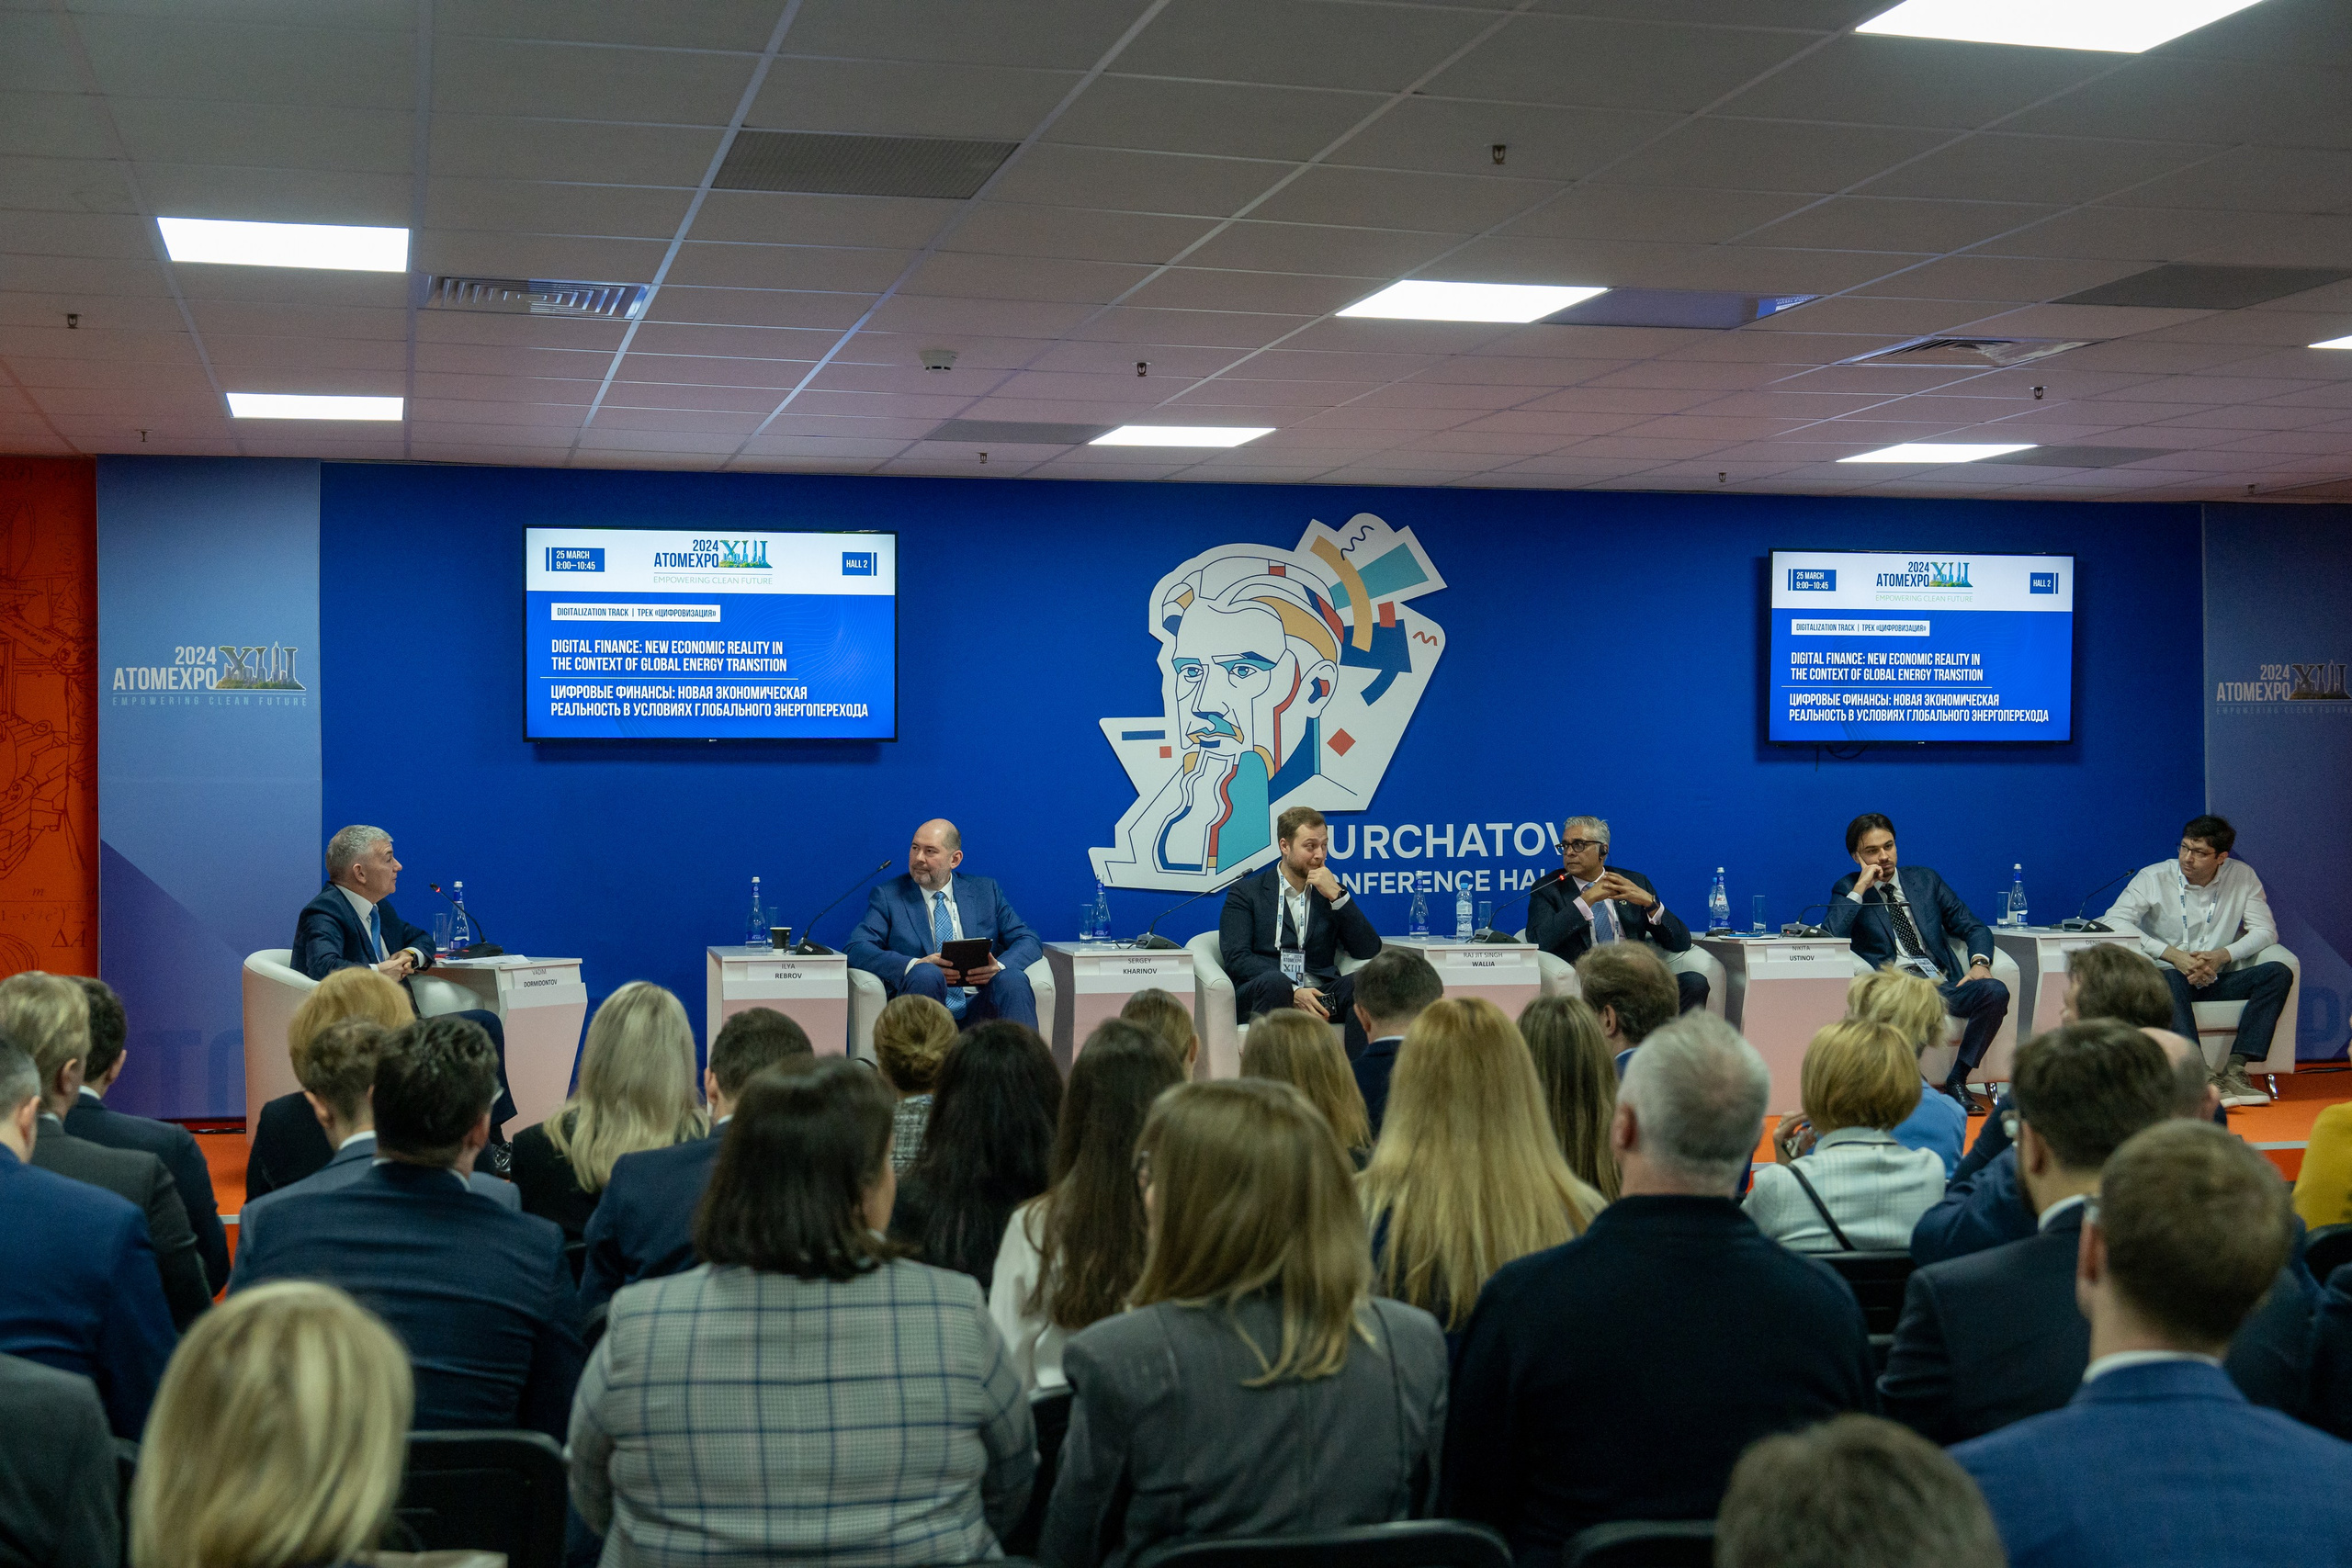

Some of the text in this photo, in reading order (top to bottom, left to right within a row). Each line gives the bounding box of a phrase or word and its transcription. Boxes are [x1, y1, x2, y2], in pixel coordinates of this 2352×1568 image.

[693, 540, 719, 552] 2024
[556, 550, 590, 559] 25 MARCH
[654, 553, 719, 568] ATOMEXPO
[846, 559, 868, 568] HALL 2
[1908, 562, 1930, 573] 2024
[654, 576, 710, 584] EMPOWERING
[712, 576, 739, 584] CLEAN
[1876, 574, 1930, 587] ATOMEXPO
[2033, 579, 2046, 587] HALL
[557, 607, 629, 616] DIGITALIZATION TRACK
[637, 608, 653, 617] ТРЕК
[1796, 623, 1837, 631] DIGITALIZATION
[552, 639, 783, 655] DIGITAL FINANCE: NEW ECONOMIC REALITY IN
[175, 646, 217, 665] 2024
[1791, 653, 1980, 666] DIGITAL FINANCE: NEW ECONOMIC REALITY IN
[551, 657, 787, 672] THE CONTEXT OF GLOBAL ENERGY TRANSITION
[113, 667, 217, 690] ATOMEXPO
[1791, 668, 1983, 681] THE CONTEXT OF GLOBAL ENERGY TRANSITION
[2260, 665, 2290, 680] 2024
[551, 685, 807, 700] ЦИФРОВЫЕ ФИНАНСЫ: НОВАЯ ЭКОНОМИЧЕСКАЯ
[2217, 682, 2290, 701] ATOMEXPO
[113, 697, 307, 706] EMPOWERING CLEAN FUTURE
[1789, 693, 1999, 708] ЦИФРОВЫЕ ФИНАНСЫ: НОВАЯ ЭКОНОМИЧЕСКАЯ
[551, 703, 868, 719] РЕАЛЬНОСТЬ В УСЛОВИЯХ ГЛОБАЛЬНОГО ЭНЕРГОПЕРЕХОДА
[1789, 709, 2049, 723] РЕАЛЬНОСТЬ В УСЛОВИЯХ ГЛОБАЛЬНОГО ЭНЕРГОПЕРЕХОДА
[1326, 822, 1563, 860] URCHATOV
[1331, 869, 1544, 894] NFERENCE HA
[524, 979, 557, 987] DORMIDONTOV
